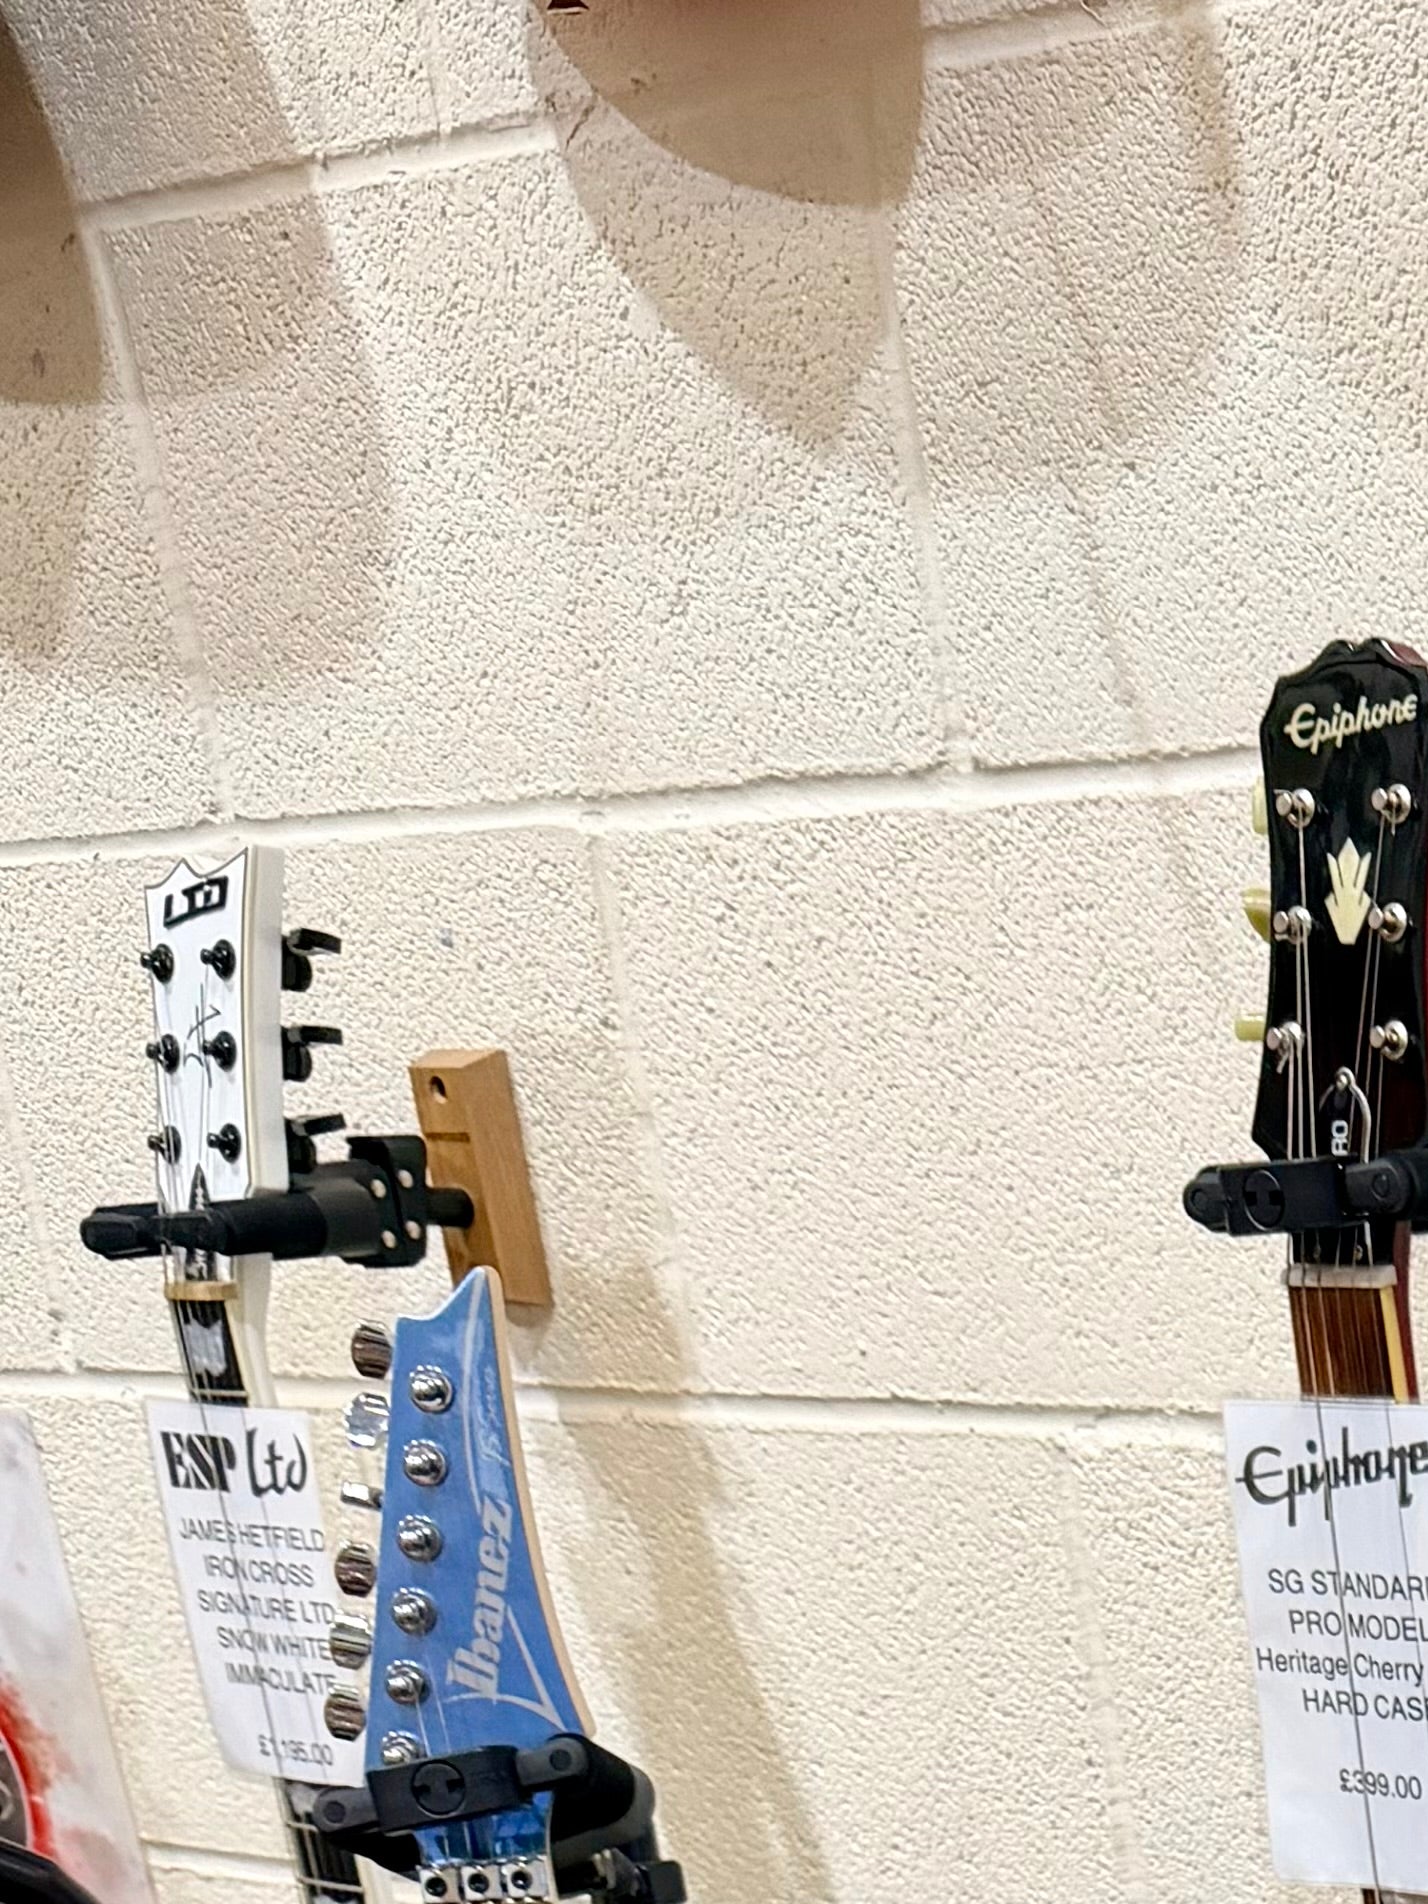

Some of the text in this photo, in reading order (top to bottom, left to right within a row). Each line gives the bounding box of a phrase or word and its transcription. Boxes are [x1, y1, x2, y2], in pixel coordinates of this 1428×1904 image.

[1283, 693, 1419, 755] Epiphone
[164, 876, 229, 928] LTD
[160, 1431, 237, 1493] ESP
[180, 1517, 325, 1552] JAMES HETFIELD
[204, 1554, 314, 1588] IRON CROSS
[1267, 1569, 1304, 1595] SG
[197, 1589, 336, 1626] SIGNATURE LTD
[445, 1500, 514, 1705] Ibanez
[1289, 1610, 1343, 1637] PRO
[217, 1626, 332, 1661] SNOW WHITE
[1255, 1648, 1349, 1680] Heritage
[1353, 1653, 1425, 1688] Cherry
[1302, 1688, 1369, 1718] HARD
[1338, 1769, 1424, 1801] £399.00
